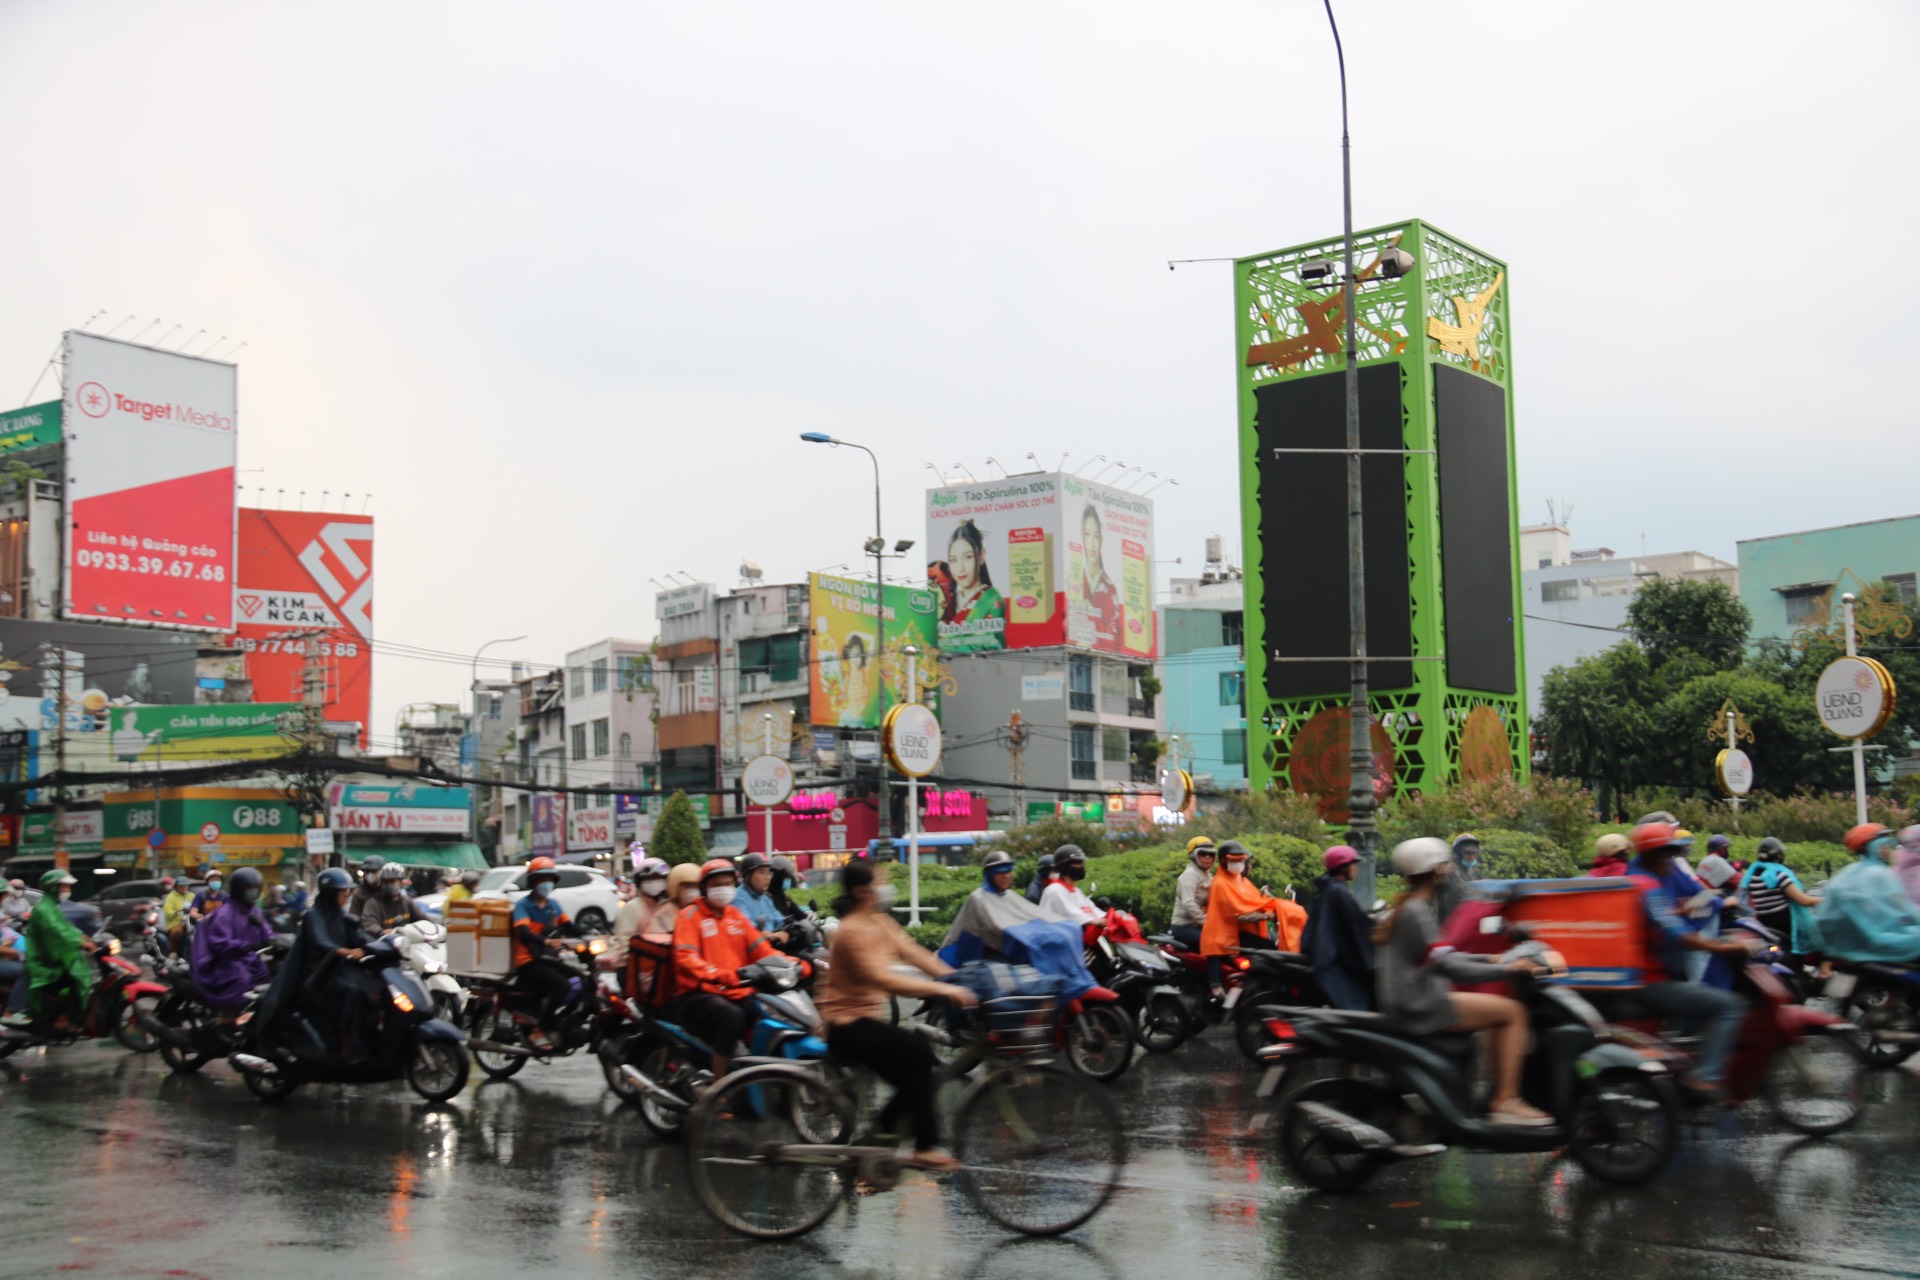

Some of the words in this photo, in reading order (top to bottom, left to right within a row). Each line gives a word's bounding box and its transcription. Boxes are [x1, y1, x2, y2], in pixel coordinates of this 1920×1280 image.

[114, 393, 172, 421] Target
[176, 404, 231, 430] Media
[984, 486, 1028, 501] Spirulina
[1029, 480, 1055, 494] 100%
[87, 530, 117, 545] Liên
[120, 534, 138, 550] hệ
[142, 538, 188, 557] Quảng
[191, 544, 217, 558] cáo
[77, 548, 225, 582] 0933.39.67.68
[818, 576, 852, 595] NGON
[854, 583, 869, 599] RÕ
[267, 596, 305, 609] KIM
[845, 597, 861, 614] RÕ
[910, 592, 932, 610] Cozy
[268, 610, 325, 622] NGAN
[961, 620, 972, 633] in
[973, 617, 1004, 632] JAPAN
[1823, 692, 1862, 708] UBND
[127, 808, 154, 830] F88
[232, 805, 281, 828] F88
[376, 810, 402, 829] TÀI
